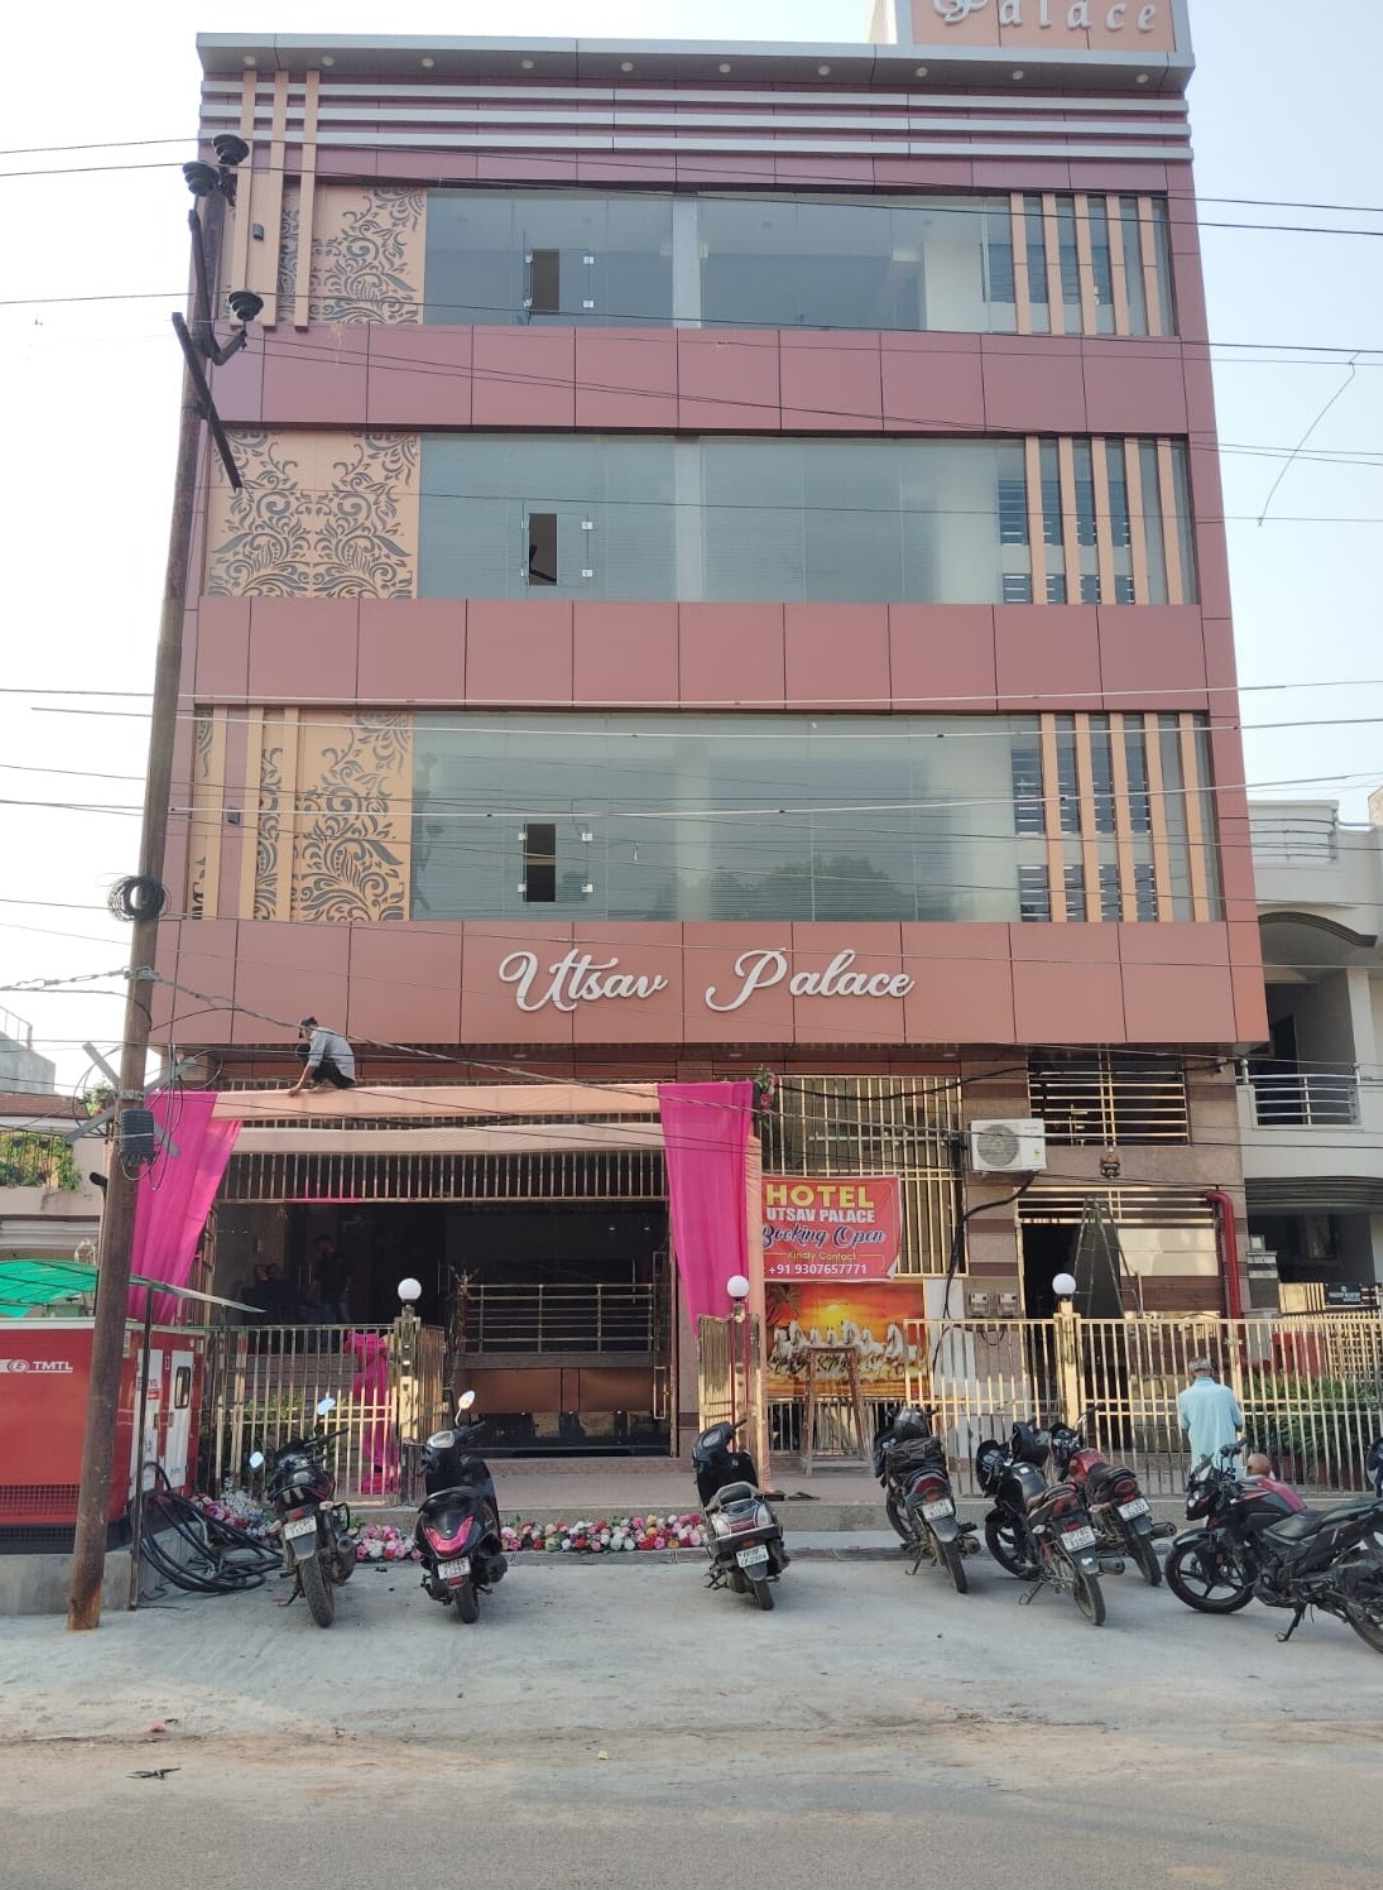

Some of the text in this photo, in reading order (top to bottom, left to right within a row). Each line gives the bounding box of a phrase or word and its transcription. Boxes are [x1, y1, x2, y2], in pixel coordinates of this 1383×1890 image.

[498, 949, 916, 1012] Utsav Palace
[766, 1184, 875, 1209] HOTEL
[766, 1207, 876, 1224] UTSAV PALACE
[762, 1223, 886, 1249] Booking Open
[787, 1251, 856, 1262] Kindly Contact
[768, 1264, 867, 1275] +91 9307657771
[32, 1361, 74, 1371] TMTL
